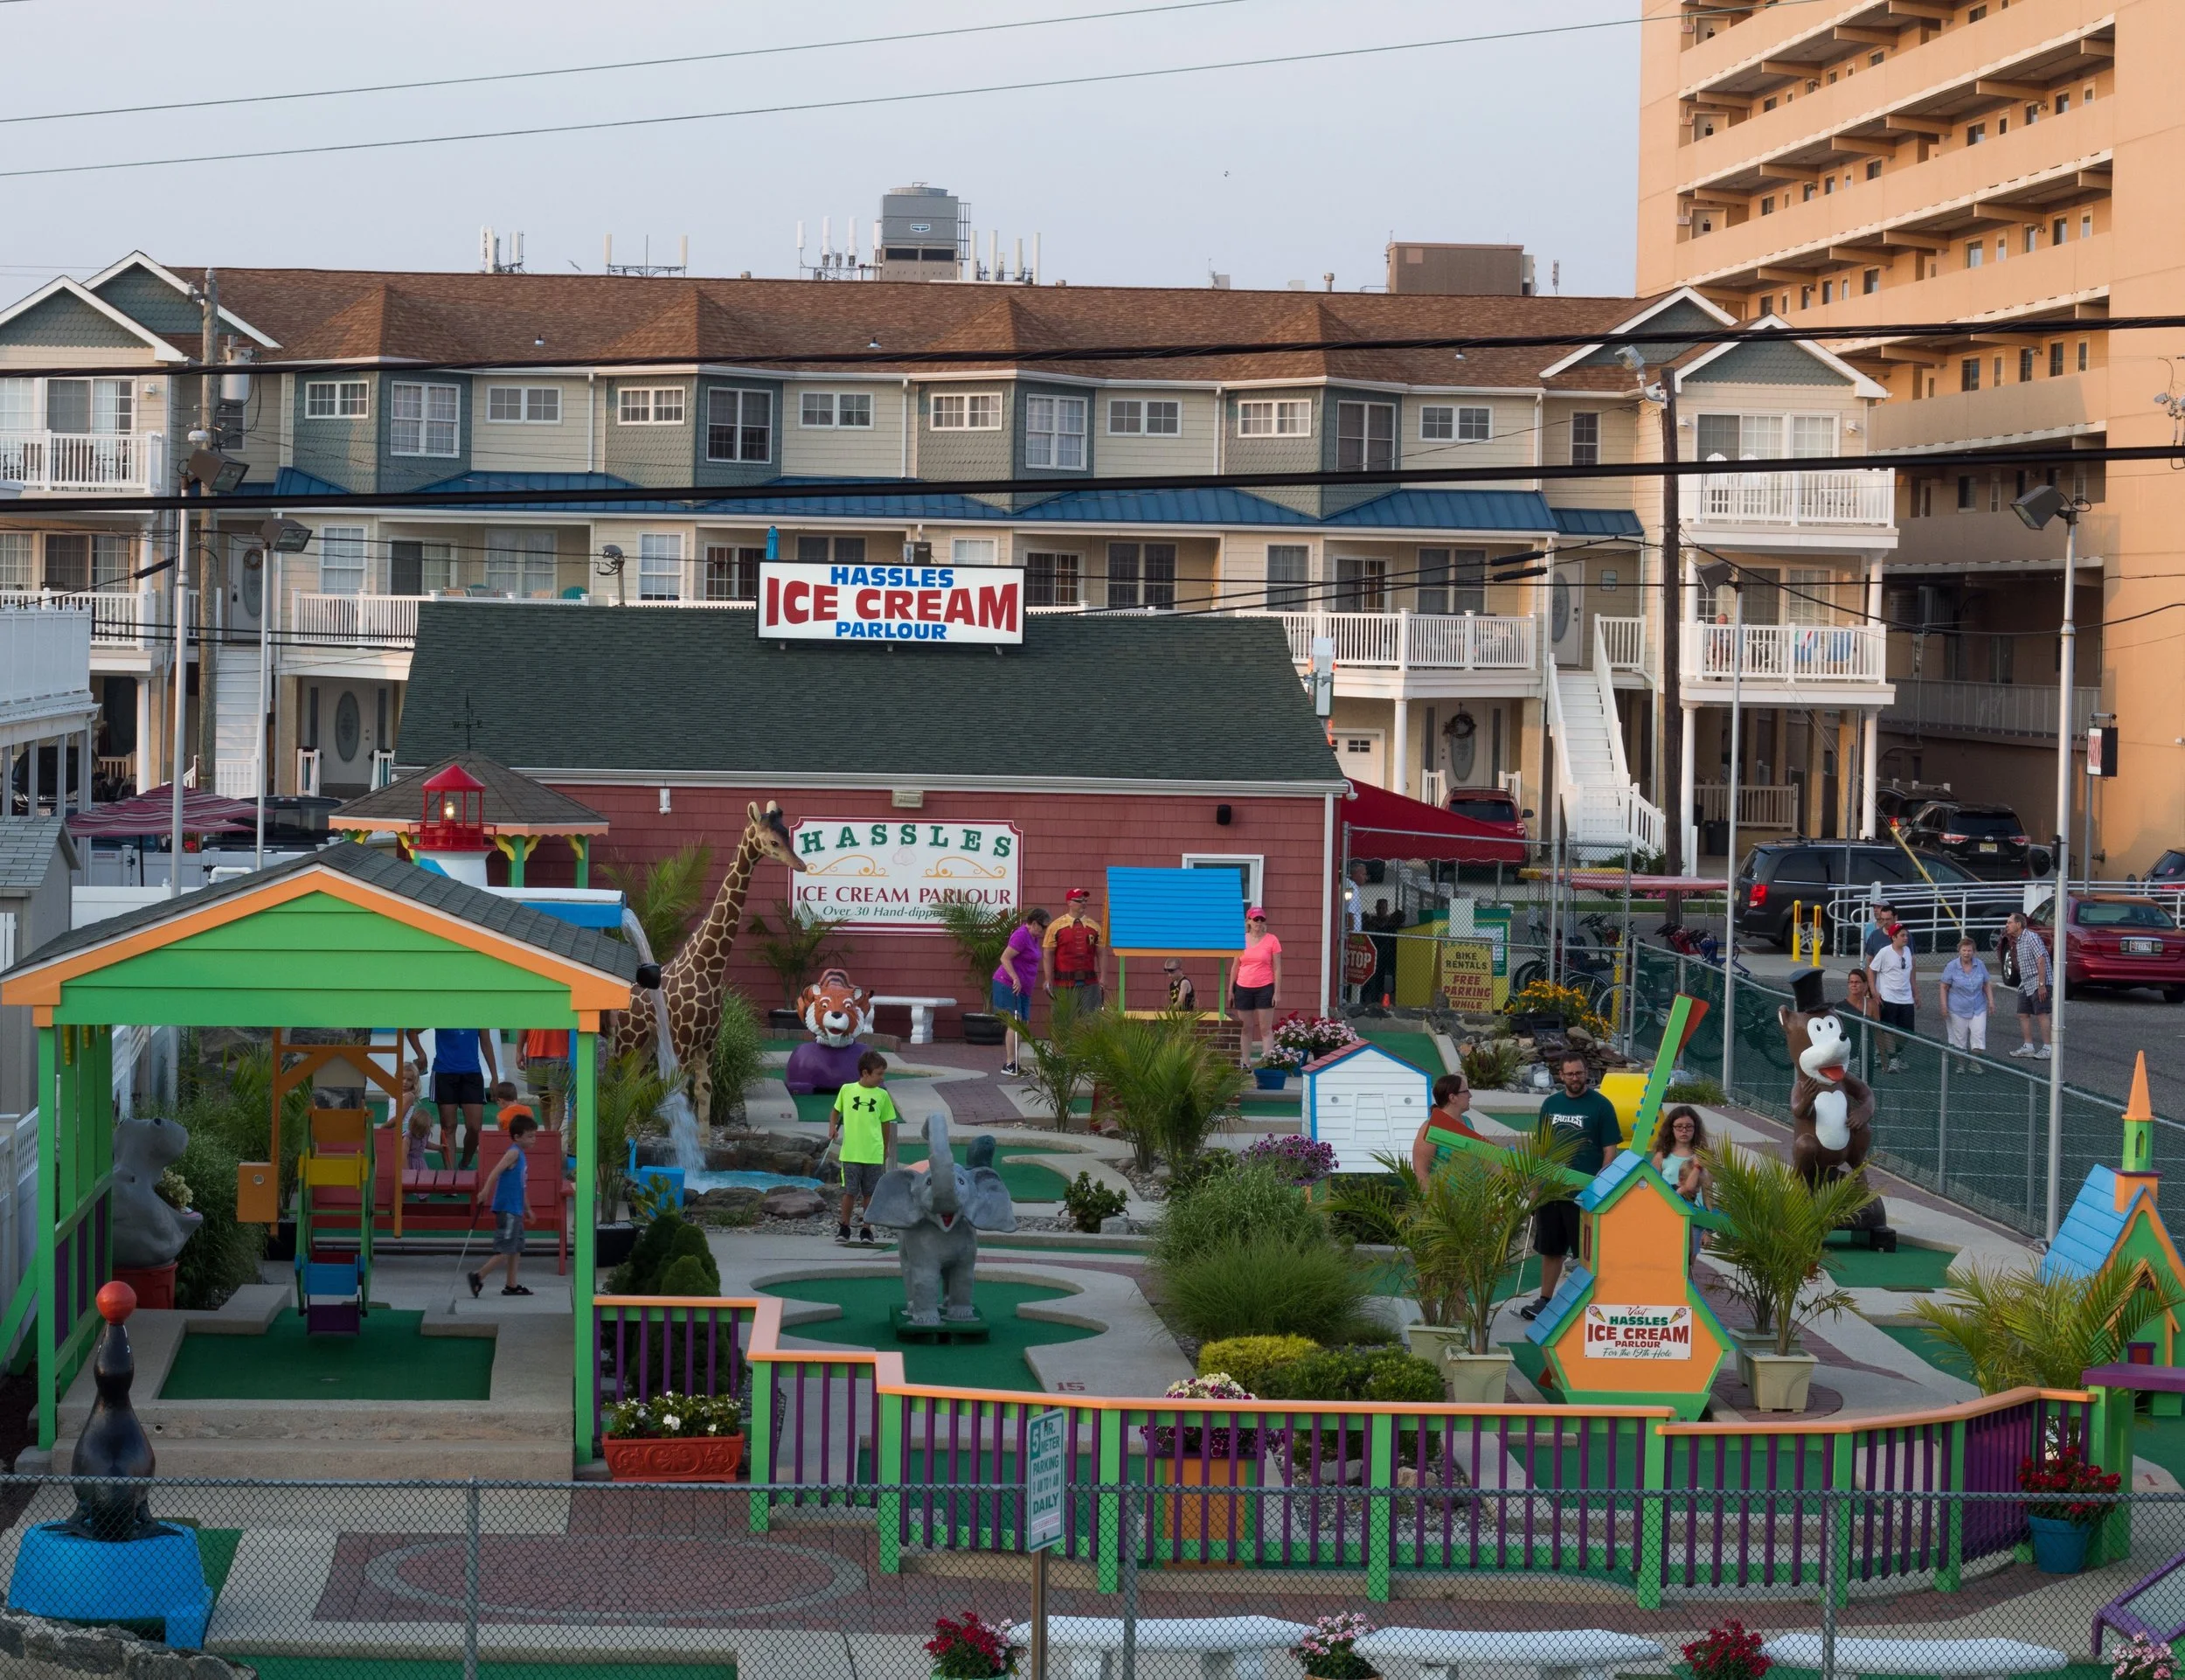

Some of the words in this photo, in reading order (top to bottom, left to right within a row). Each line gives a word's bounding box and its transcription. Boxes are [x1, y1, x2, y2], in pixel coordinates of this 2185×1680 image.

[830, 566, 954, 588] HASSLES
[766, 577, 838, 627] ICE
[856, 583, 1018, 633] CREAM
[836, 621, 947, 640] PARLOUR
[800, 823, 1012, 857] HASSLES
[796, 885, 828, 902] ICE
[836, 886, 910, 903] CREAM
[919, 887, 1011, 905] PARLOUR
[822, 906, 851, 917] Over
[856, 906, 869, 917] 30
[1345, 949, 1372, 969] STOP
[1455, 951, 1477, 961] BIKE
[1446, 960, 1488, 970] RENTALS
[1453, 975, 1481, 986] FREE
[1443, 985, 1491, 997] PARKING
[1452, 999, 1483, 1010] WHILE
[1551, 1113, 1583, 1128] EAGLES
[1626, 1306, 1652, 1316] Visit
[1609, 1316, 1668, 1326] HASSLES
[1587, 1323, 1617, 1343] ICE
[1623, 1324, 1689, 1344] CREAM
[1615, 1340, 1661, 1349] PARLOUR
[1603, 1347, 1617, 1357] For
[1620, 1347, 1631, 1357] the
[1632, 1348, 1649, 1357] 19th
[1651, 1348, 1672, 1359] Hole
[1057, 1382, 1086, 1391] 15
[1032, 1427, 1040, 1453] 5
[1041, 1436, 1060, 1454] METER
[1032, 1454, 1059, 1477] PARKING
[1033, 1492, 1059, 1515] DAILY
